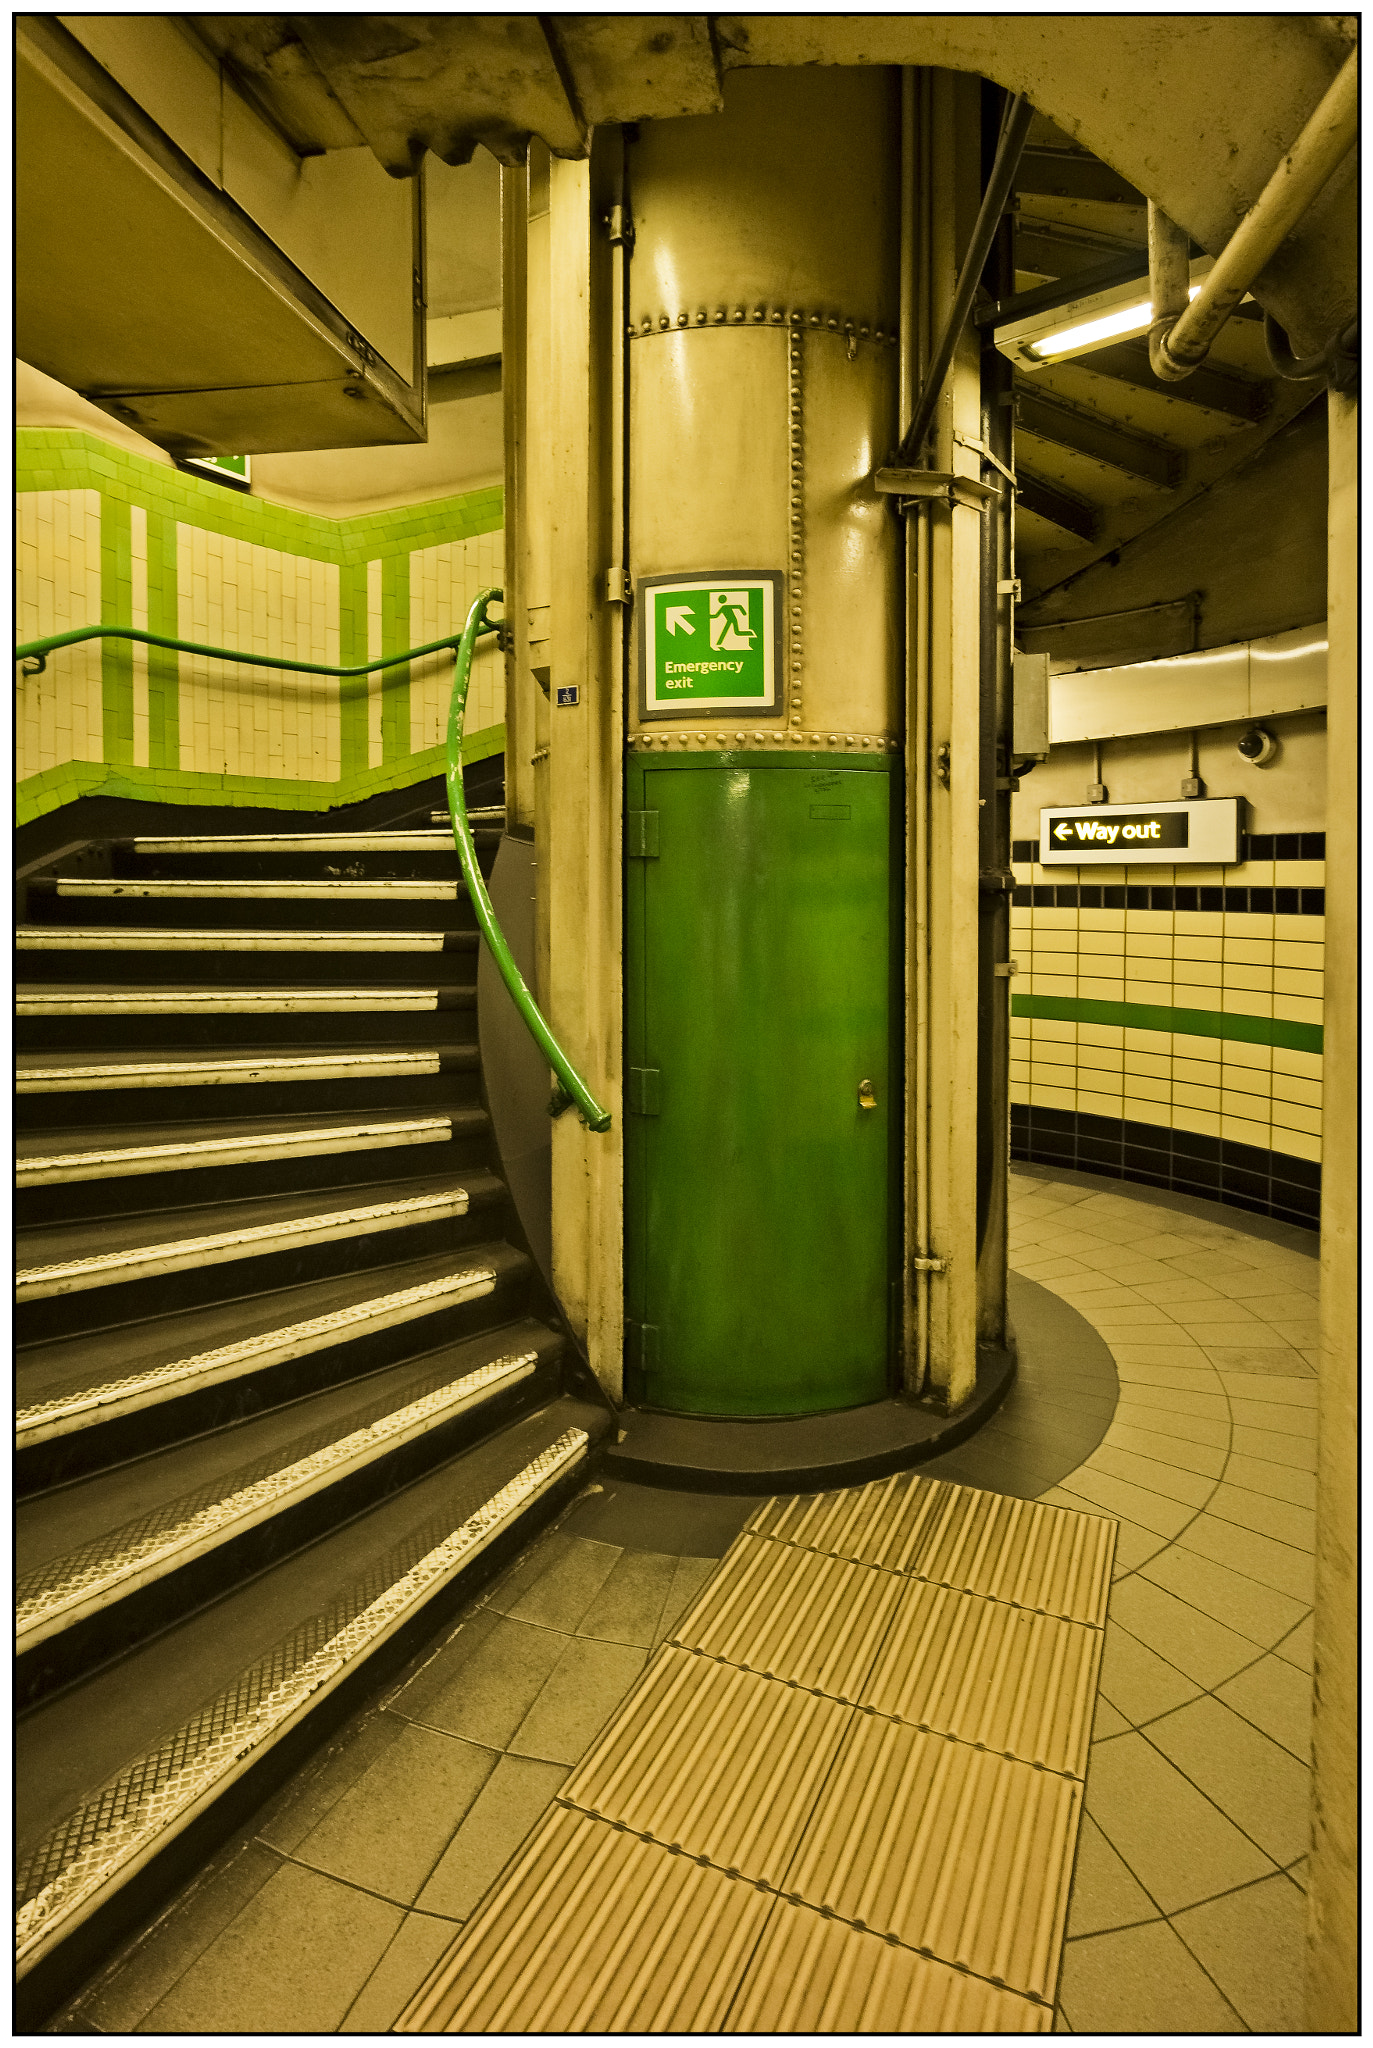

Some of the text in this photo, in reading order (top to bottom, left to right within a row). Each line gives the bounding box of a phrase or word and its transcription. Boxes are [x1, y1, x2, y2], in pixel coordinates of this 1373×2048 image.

[665, 661, 744, 675] Emergency
[665, 676, 694, 689] exit
[1074, 821, 1161, 844] Way out
